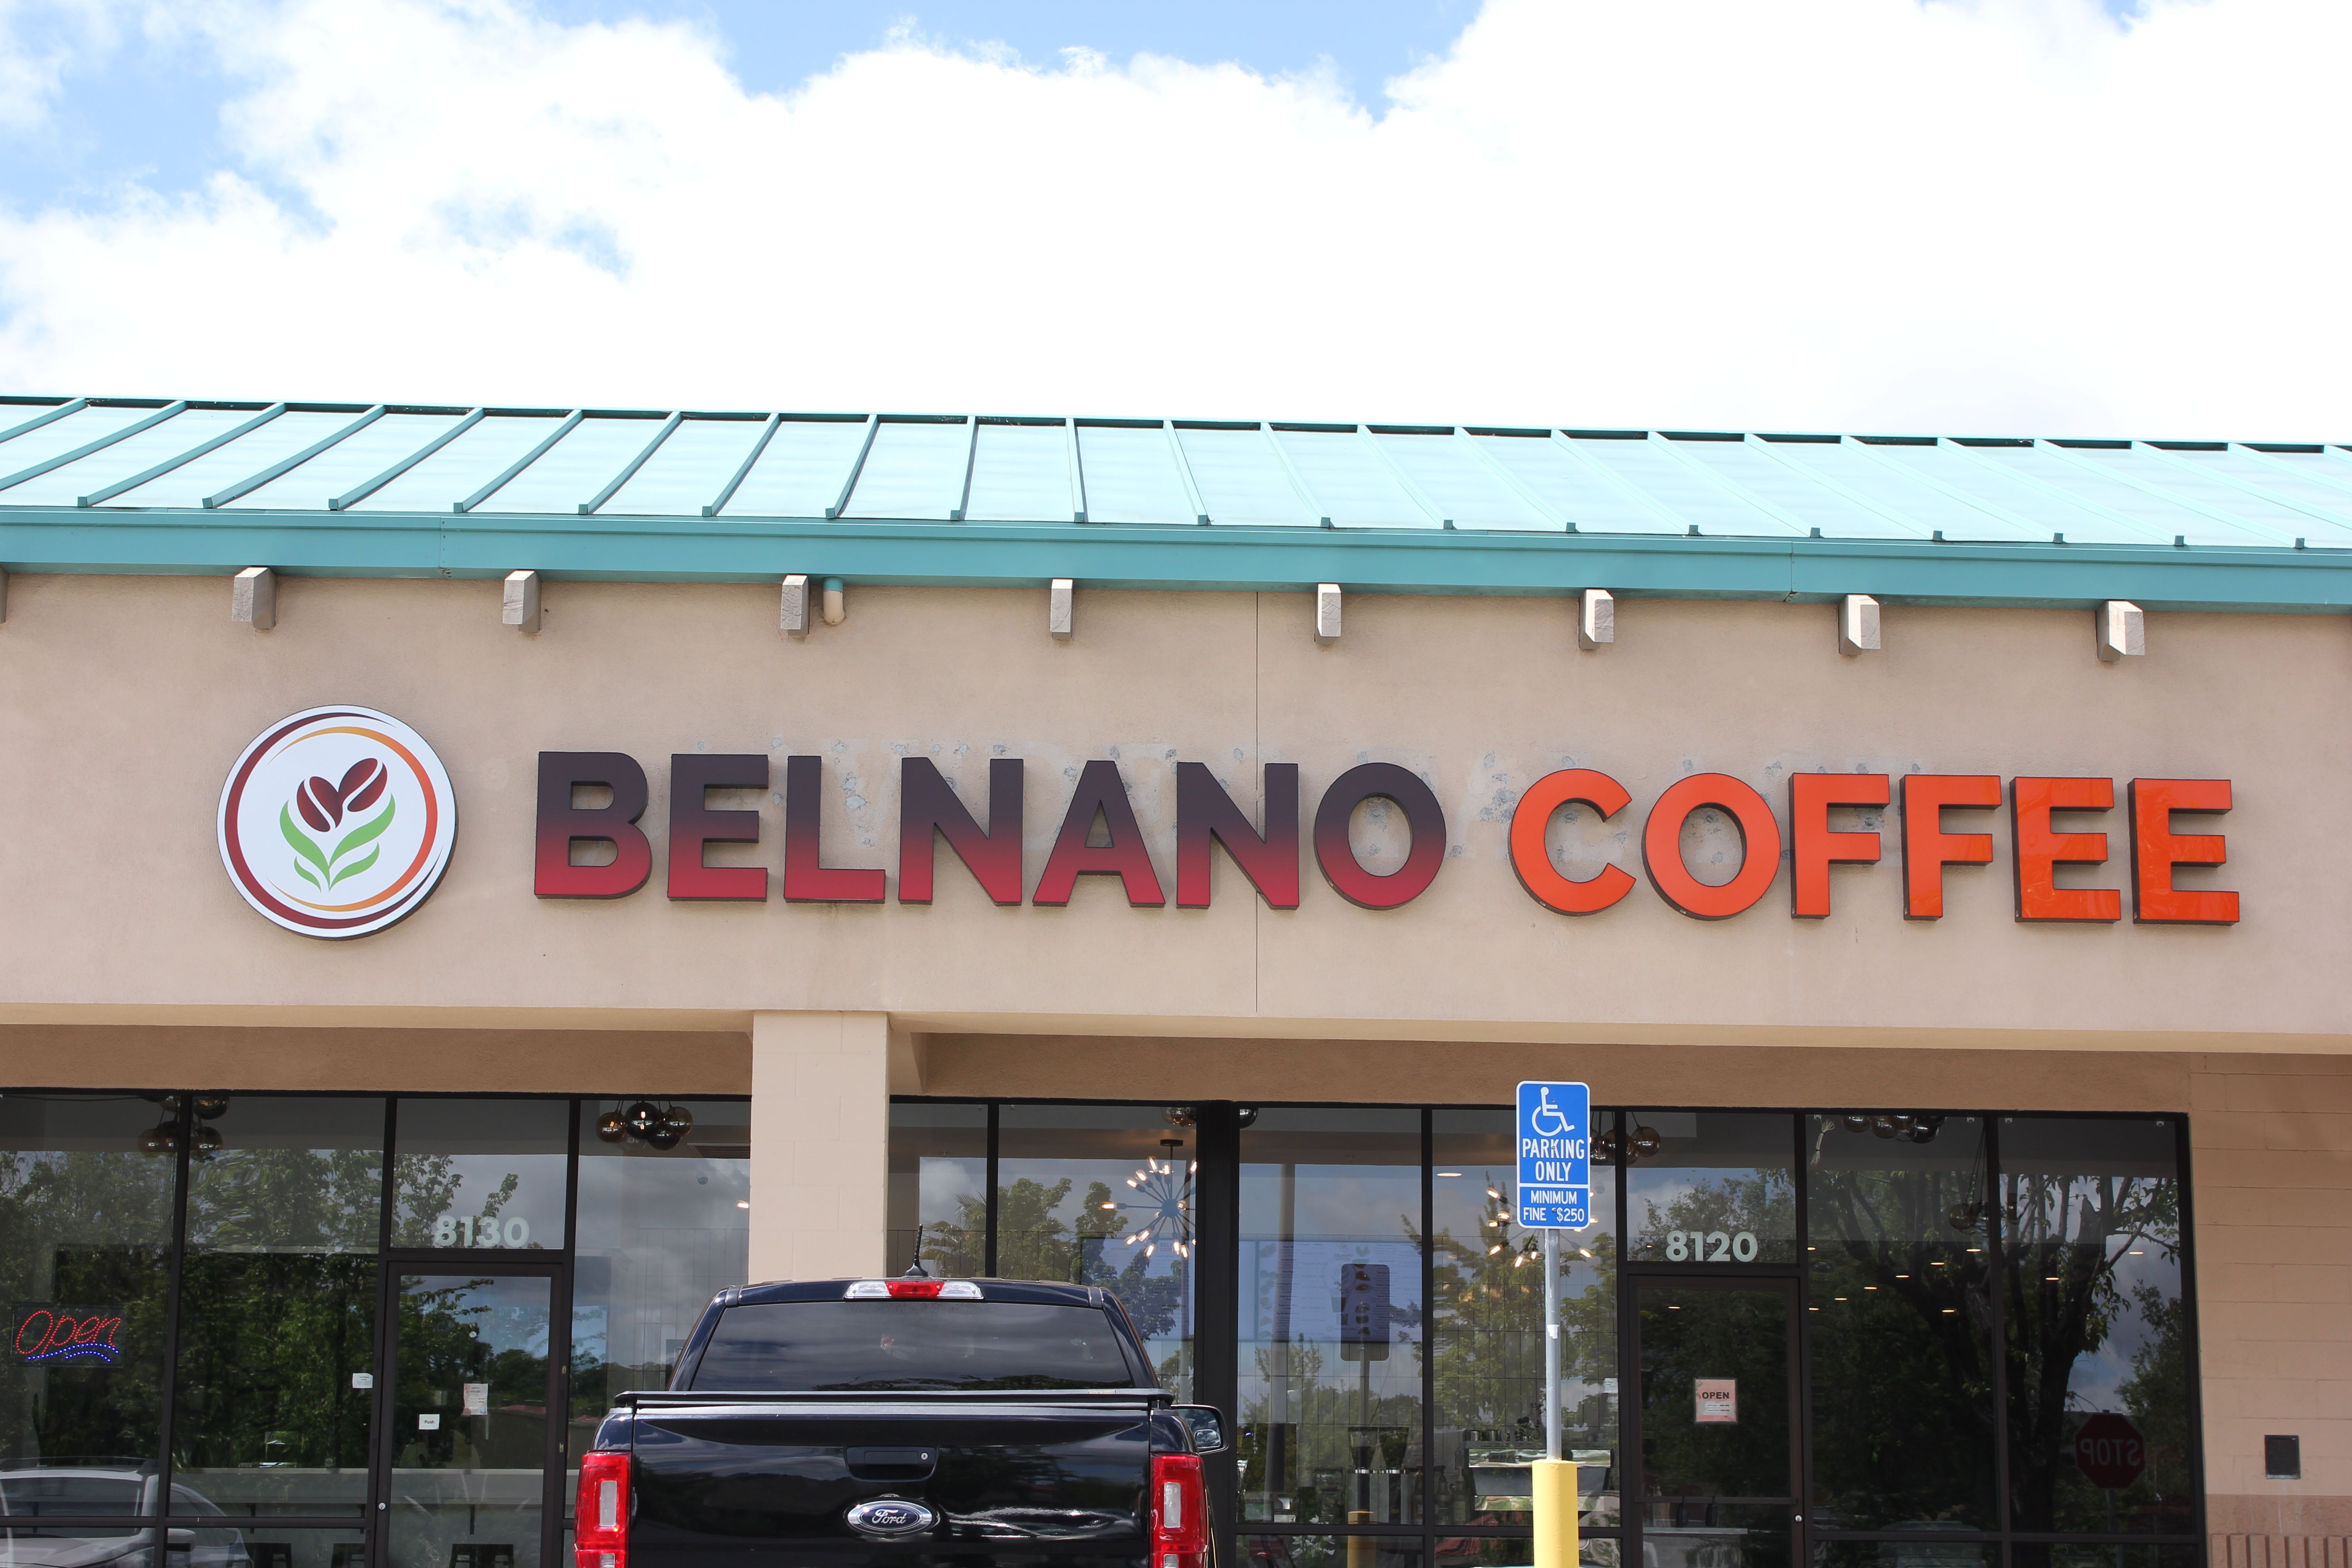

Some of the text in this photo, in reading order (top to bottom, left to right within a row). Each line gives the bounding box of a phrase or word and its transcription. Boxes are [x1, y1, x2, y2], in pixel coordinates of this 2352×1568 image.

[534, 751, 2240, 925] BELNANO COFFEE
[1522, 1138, 1585, 1160] PARKING
[1535, 1161, 1572, 1181] ONLY
[1530, 1190, 1578, 1205] MINIMUM
[1523, 1206, 1585, 1223] FINE $250
[434, 1215, 530, 1248] 8130
[1666, 1231, 1758, 1263] 8120
[15, 1310, 122, 1355] Open
[871, 1509, 907, 1524] Ford
